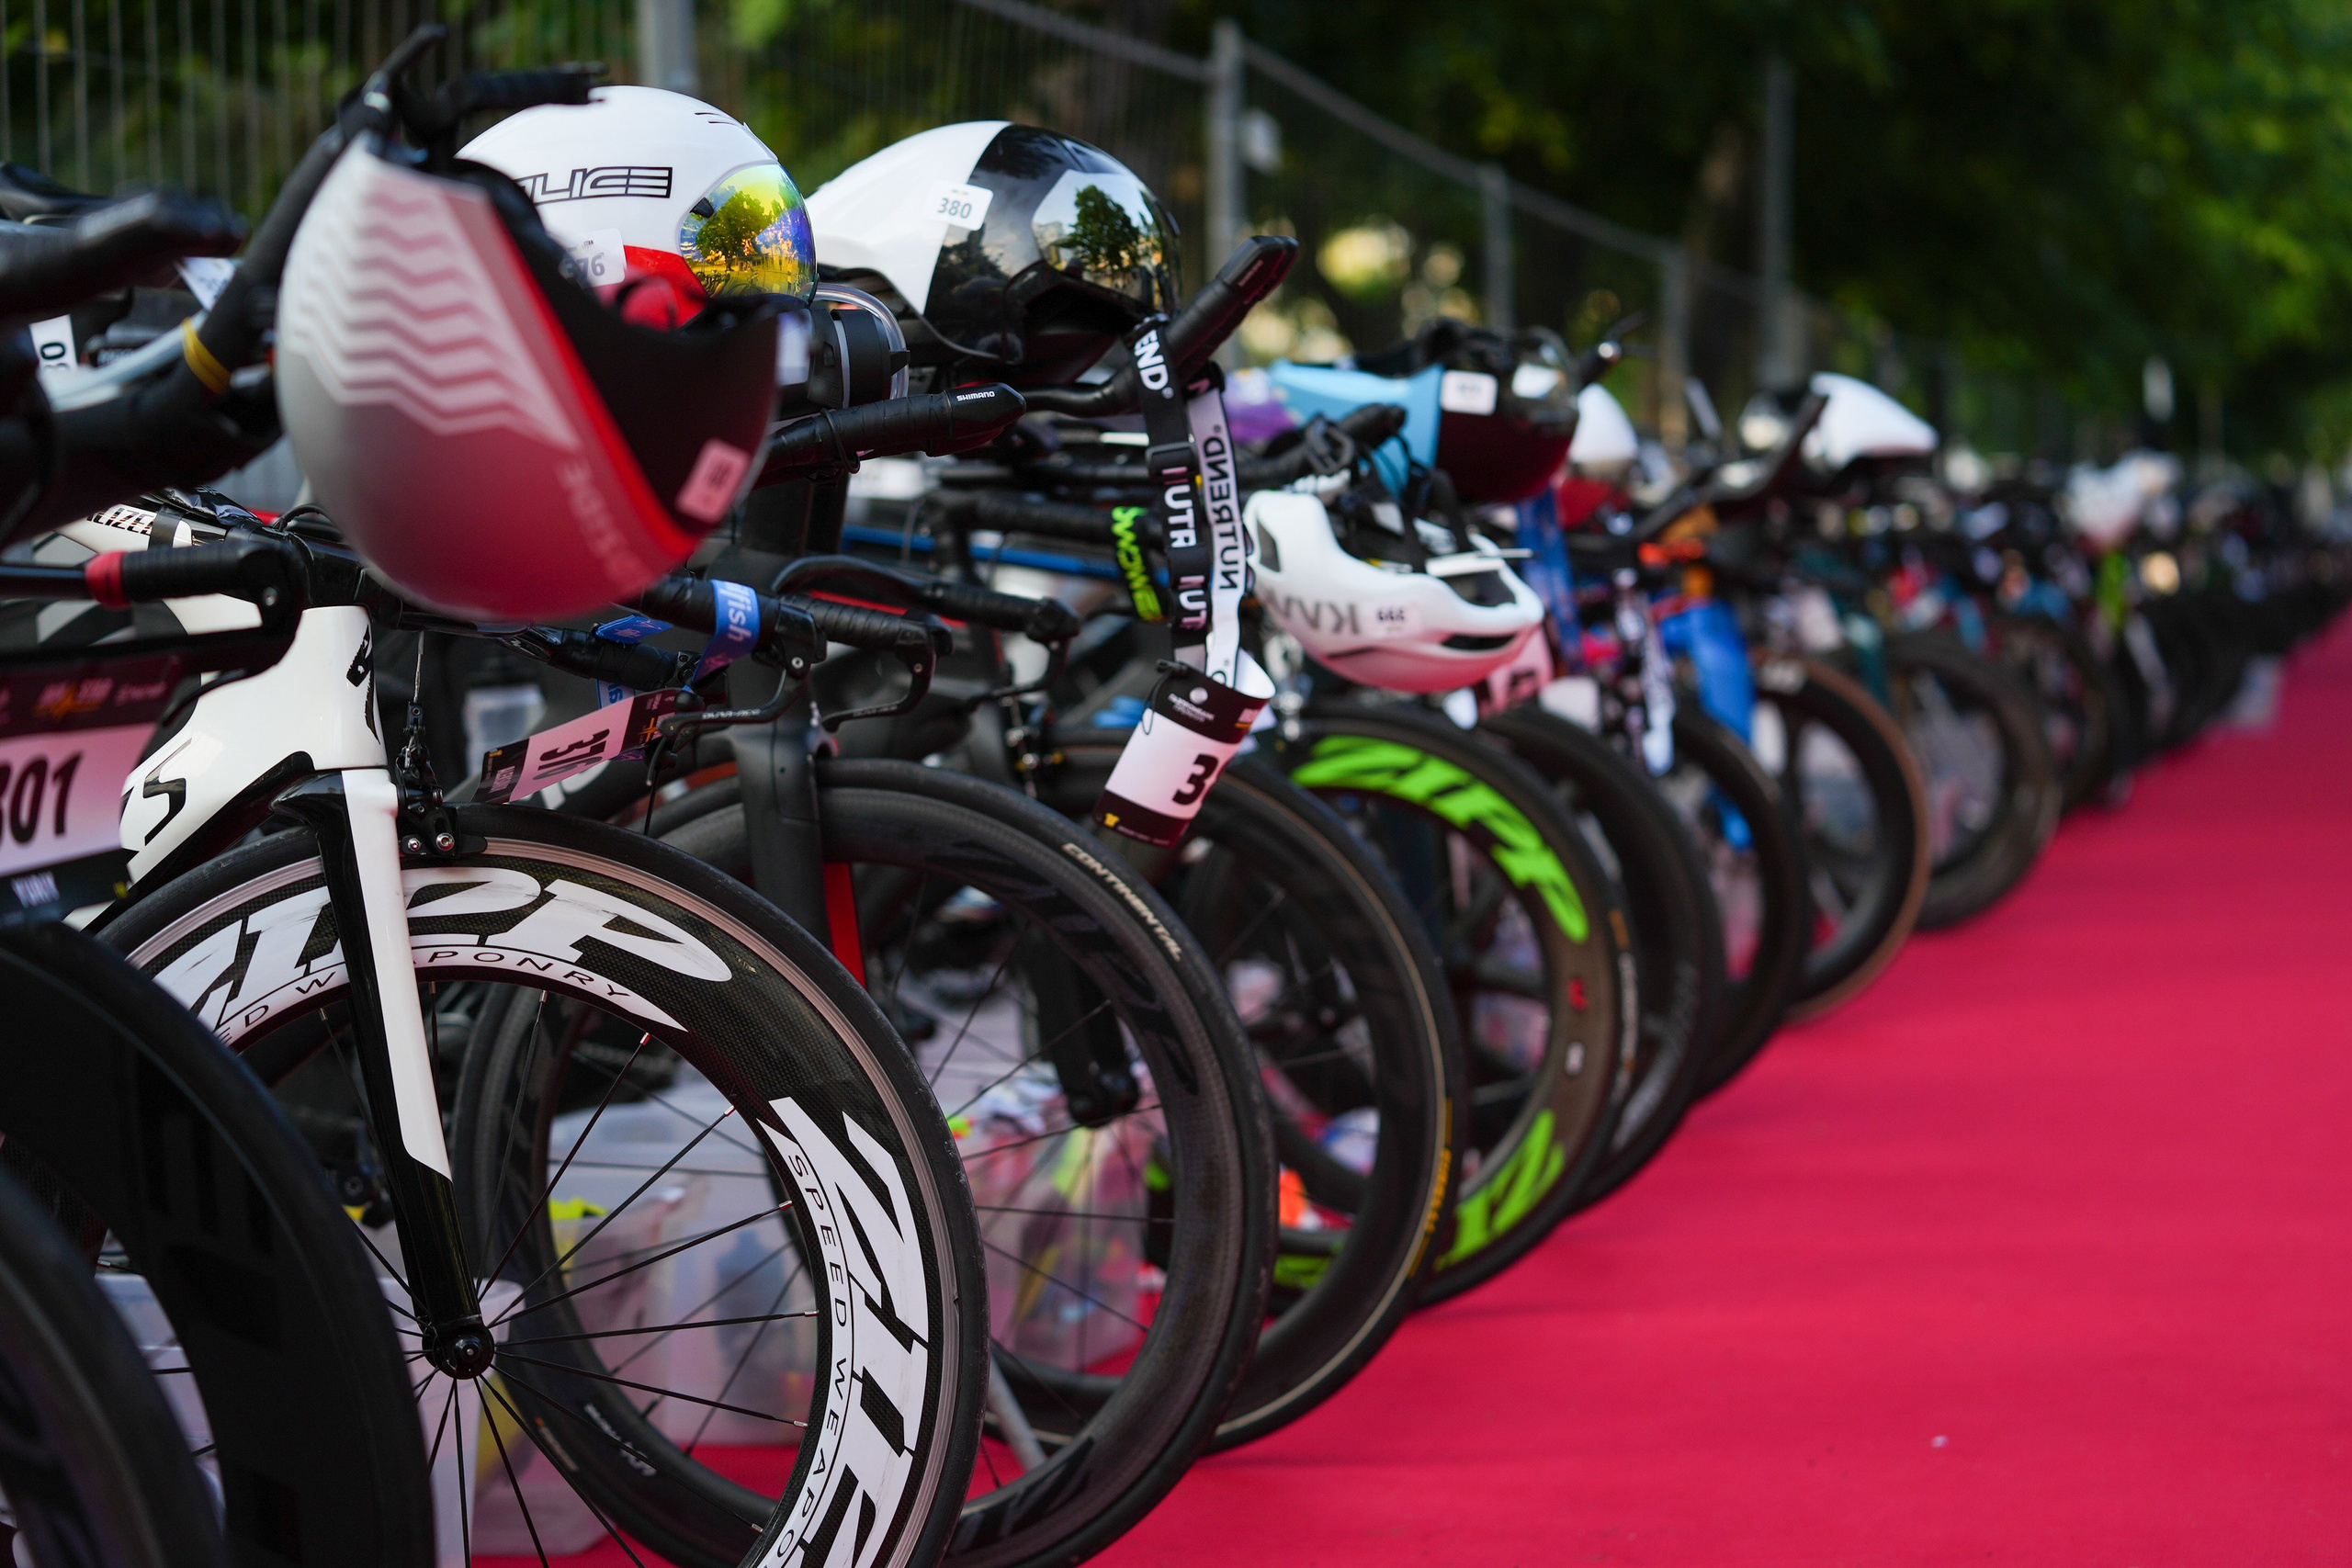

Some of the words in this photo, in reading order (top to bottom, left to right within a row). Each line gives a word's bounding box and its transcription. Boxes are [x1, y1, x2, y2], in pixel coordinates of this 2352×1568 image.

[937, 197, 972, 219] 380
[956, 390, 995, 401] SHIMANO
[1062, 842, 1182, 962] CONTINENTAL
[295, 949, 631, 997] WPONRY
[787, 1154, 848, 1328] SPEED
